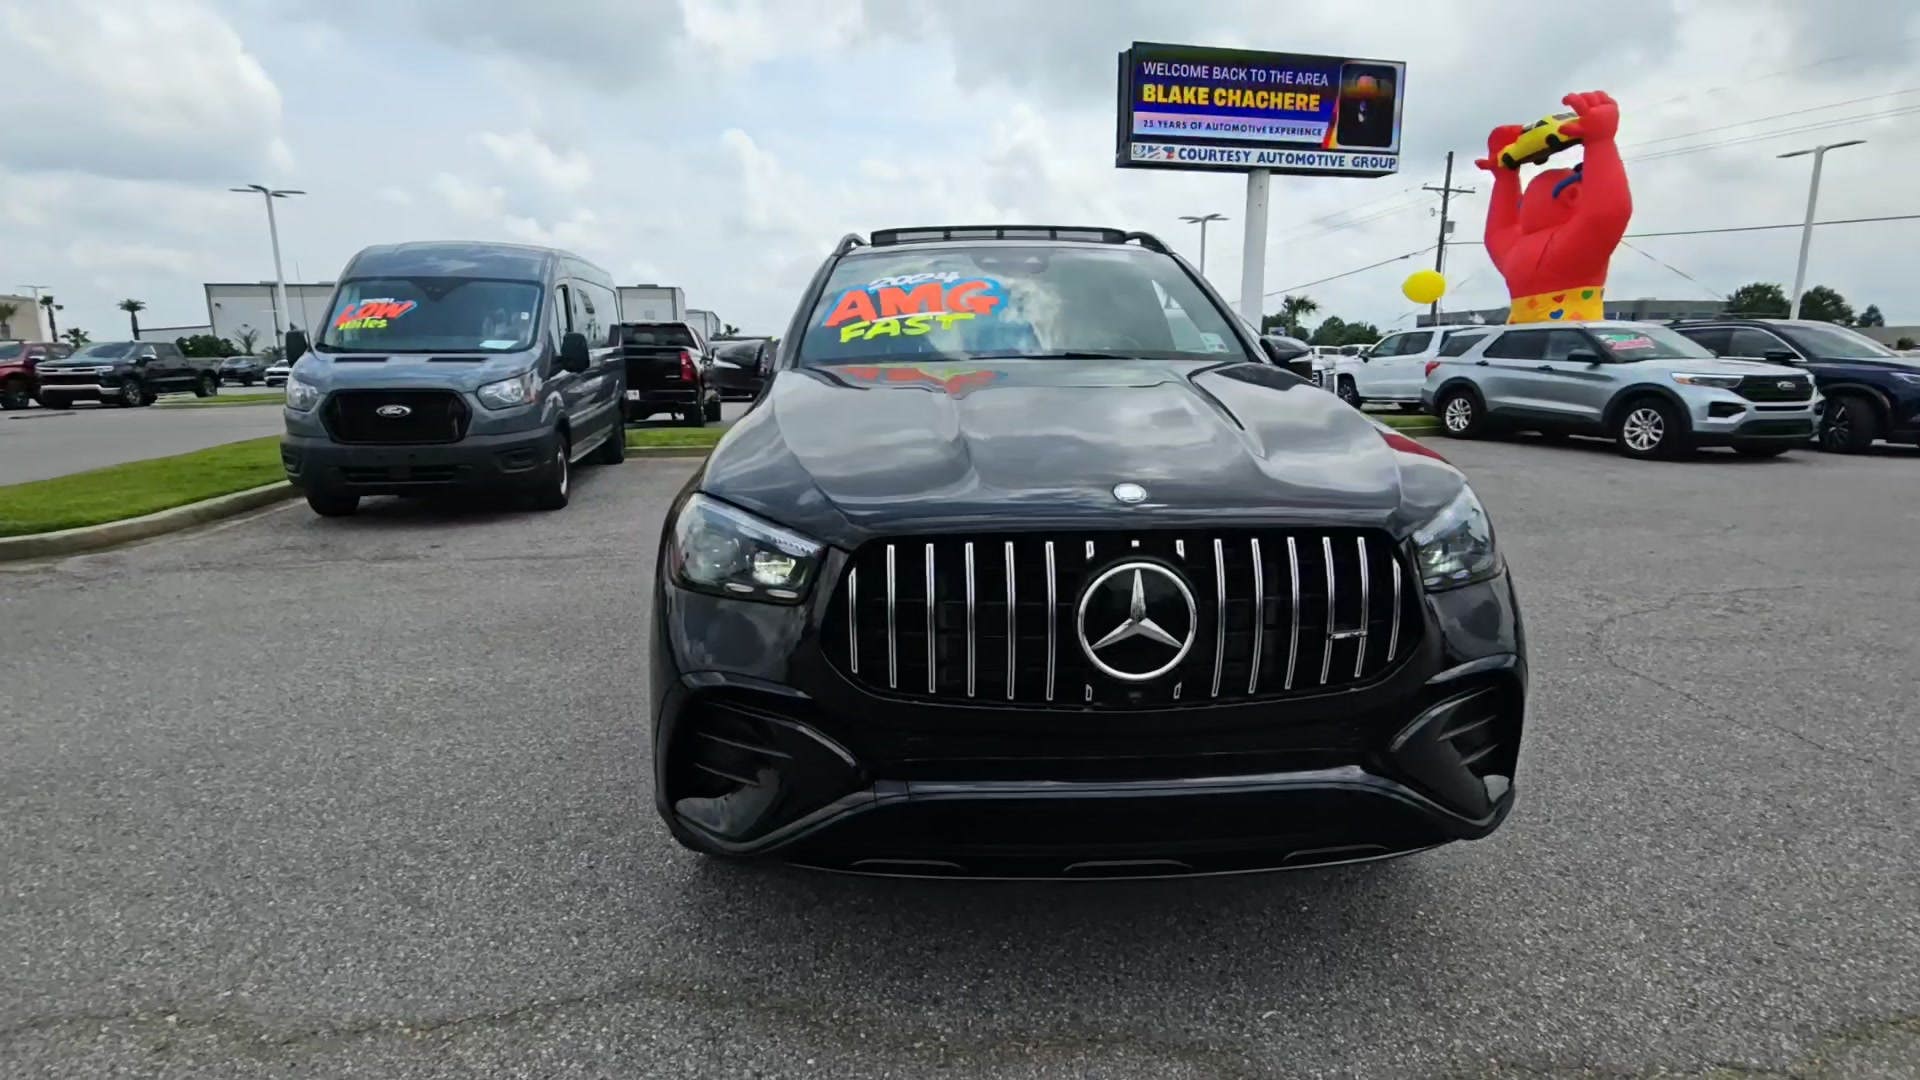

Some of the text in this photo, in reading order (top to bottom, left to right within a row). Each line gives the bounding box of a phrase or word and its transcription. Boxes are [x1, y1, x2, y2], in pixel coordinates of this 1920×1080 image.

[1143, 61, 1328, 87] WELCOME BACK TO THE AREA
[1142, 83, 1321, 112] BLAKE CHACHERE
[1157, 120, 1187, 130] YEARS
[1190, 121, 1203, 130] OF
[1205, 122, 1267, 134] AUTOMOTIVE
[1269, 125, 1322, 137] EXPERIENCE
[1178, 147, 1251, 163] COURTESY
[1257, 150, 1345, 167] AUTOMOTIVE
[1351, 154, 1397, 170] GROUP
[334, 301, 414, 327] LOW
[823, 280, 999, 328] AMG
[839, 313, 976, 344] FAST
